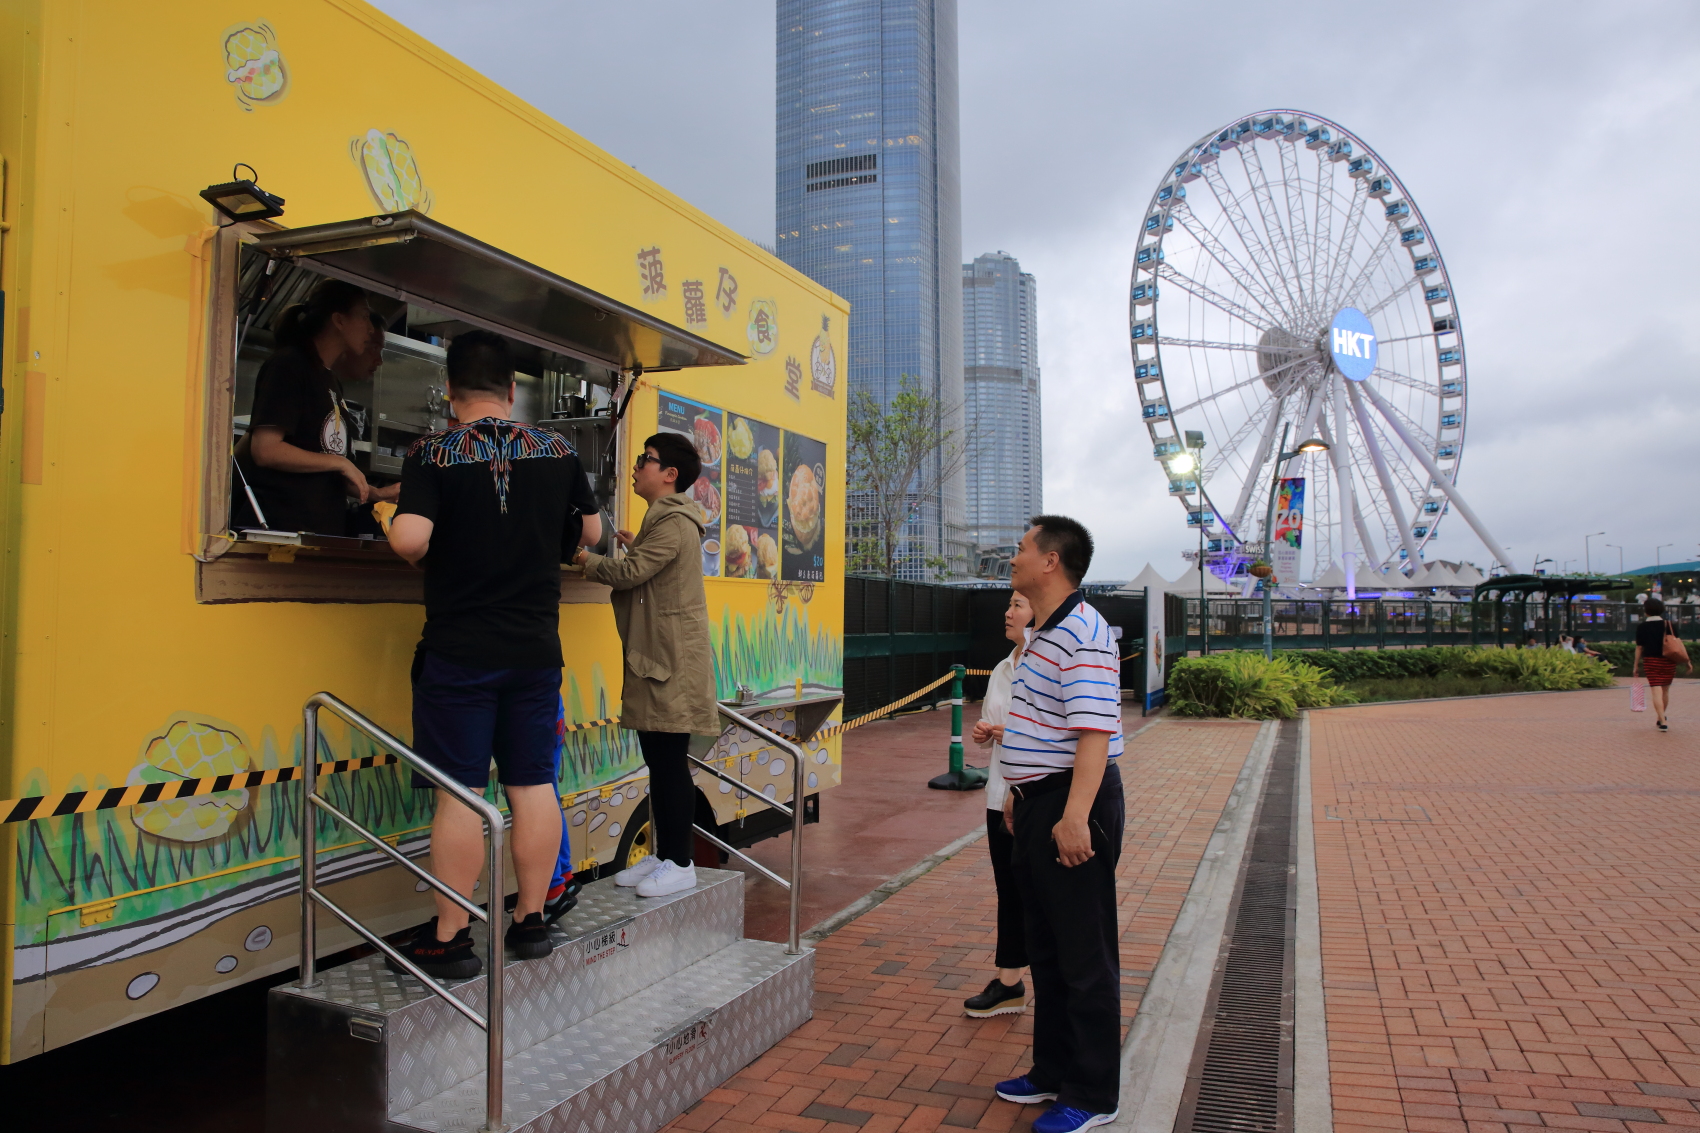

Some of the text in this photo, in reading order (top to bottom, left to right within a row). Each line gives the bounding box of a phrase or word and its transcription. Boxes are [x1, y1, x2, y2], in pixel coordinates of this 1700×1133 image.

[1333, 328, 1374, 359] HKT
[668, 402, 685, 415] MENU
[1276, 509, 1301, 530] 20
[813, 554, 823, 567] $20
[586, 931, 615, 954] 小心梯級
[586, 947, 615, 966] MIND THE STEP
[668, 1027, 696, 1055] 小心地滑
